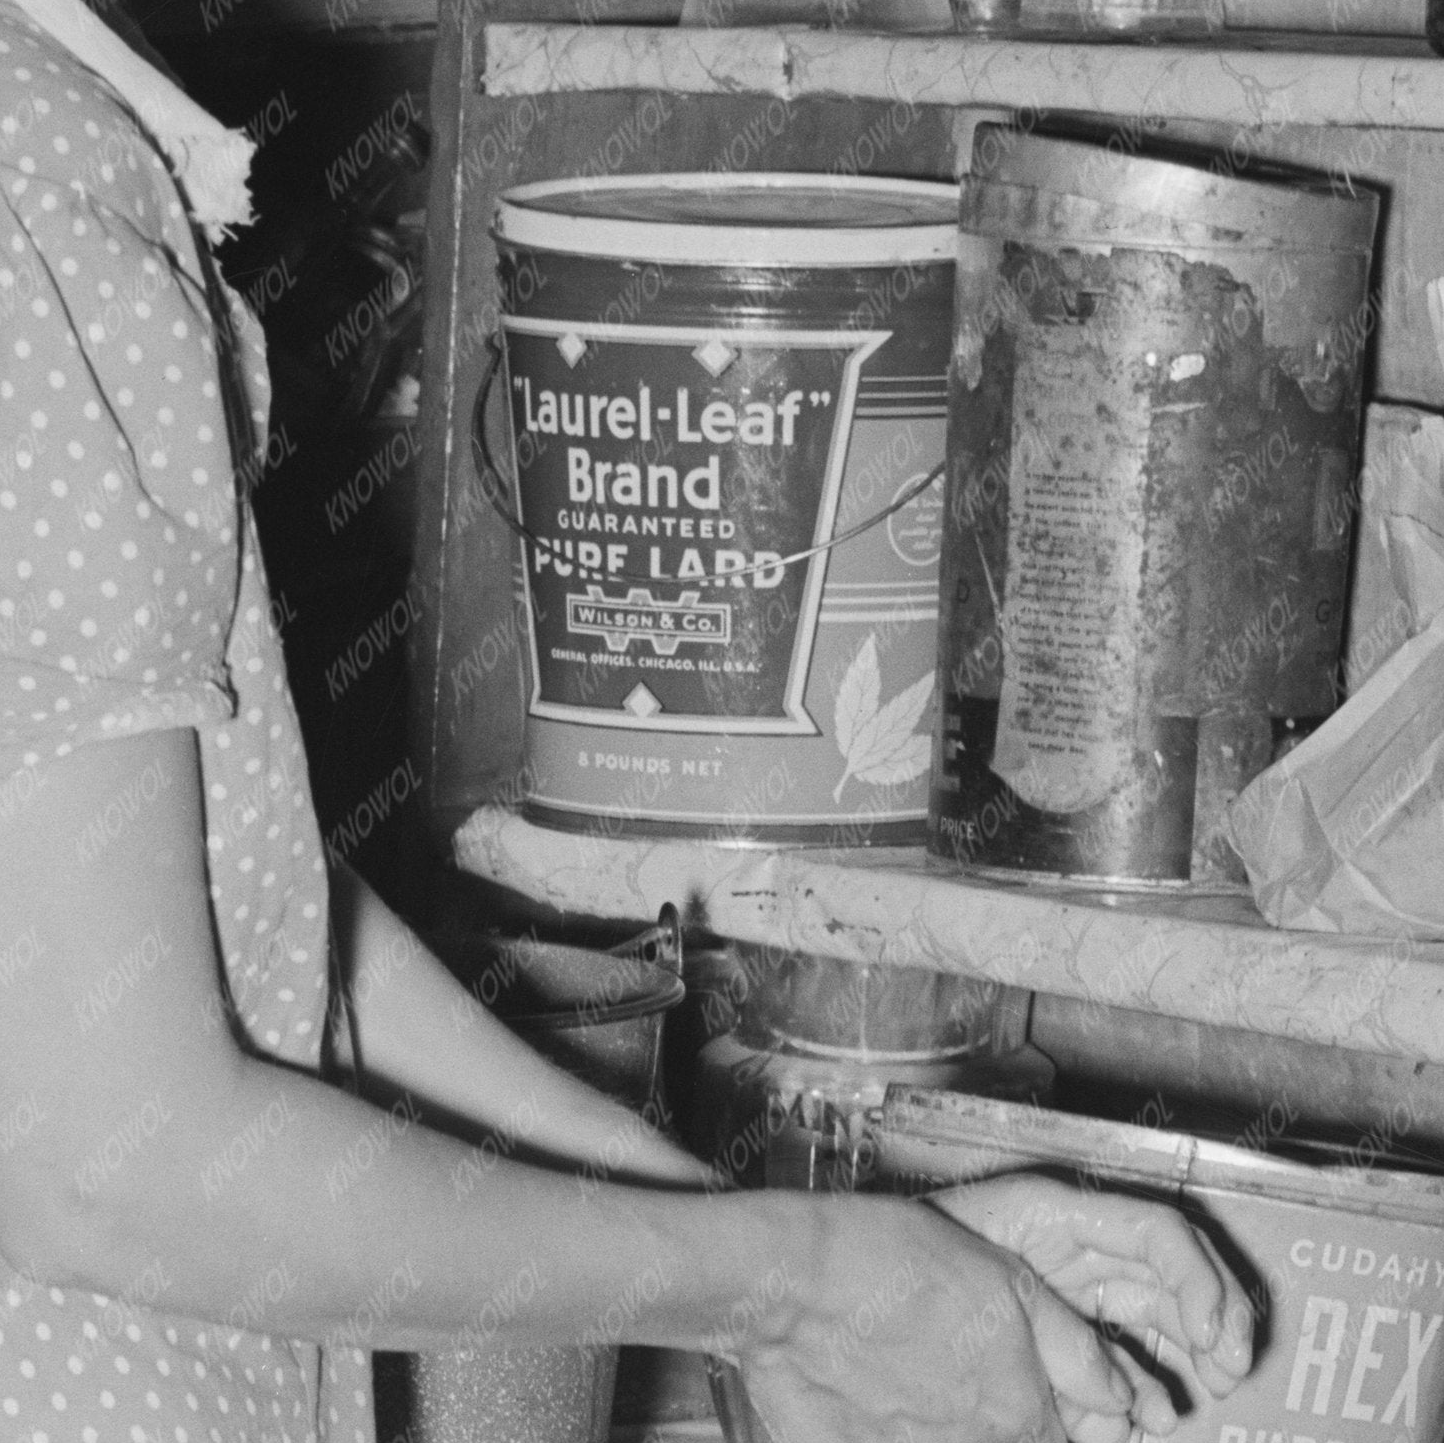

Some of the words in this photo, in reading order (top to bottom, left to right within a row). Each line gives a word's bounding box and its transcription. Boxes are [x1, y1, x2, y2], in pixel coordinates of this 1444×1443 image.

[513, 375, 832, 446] "Laurel-Leaf"
[568, 446, 721, 510] Brand
[557, 508, 737, 540] GUARANTEED
[534, 536, 629, 583] PURE
[649, 545, 786, 589] LARD
[659, 612, 676, 631] &
[550, 647, 588, 664] GENERAL
[577, 750, 590, 768] 8
[595, 751, 671, 775] POUNDS
[681, 759, 723, 777] NET
[1285, 1294, 1444, 1428] REX
